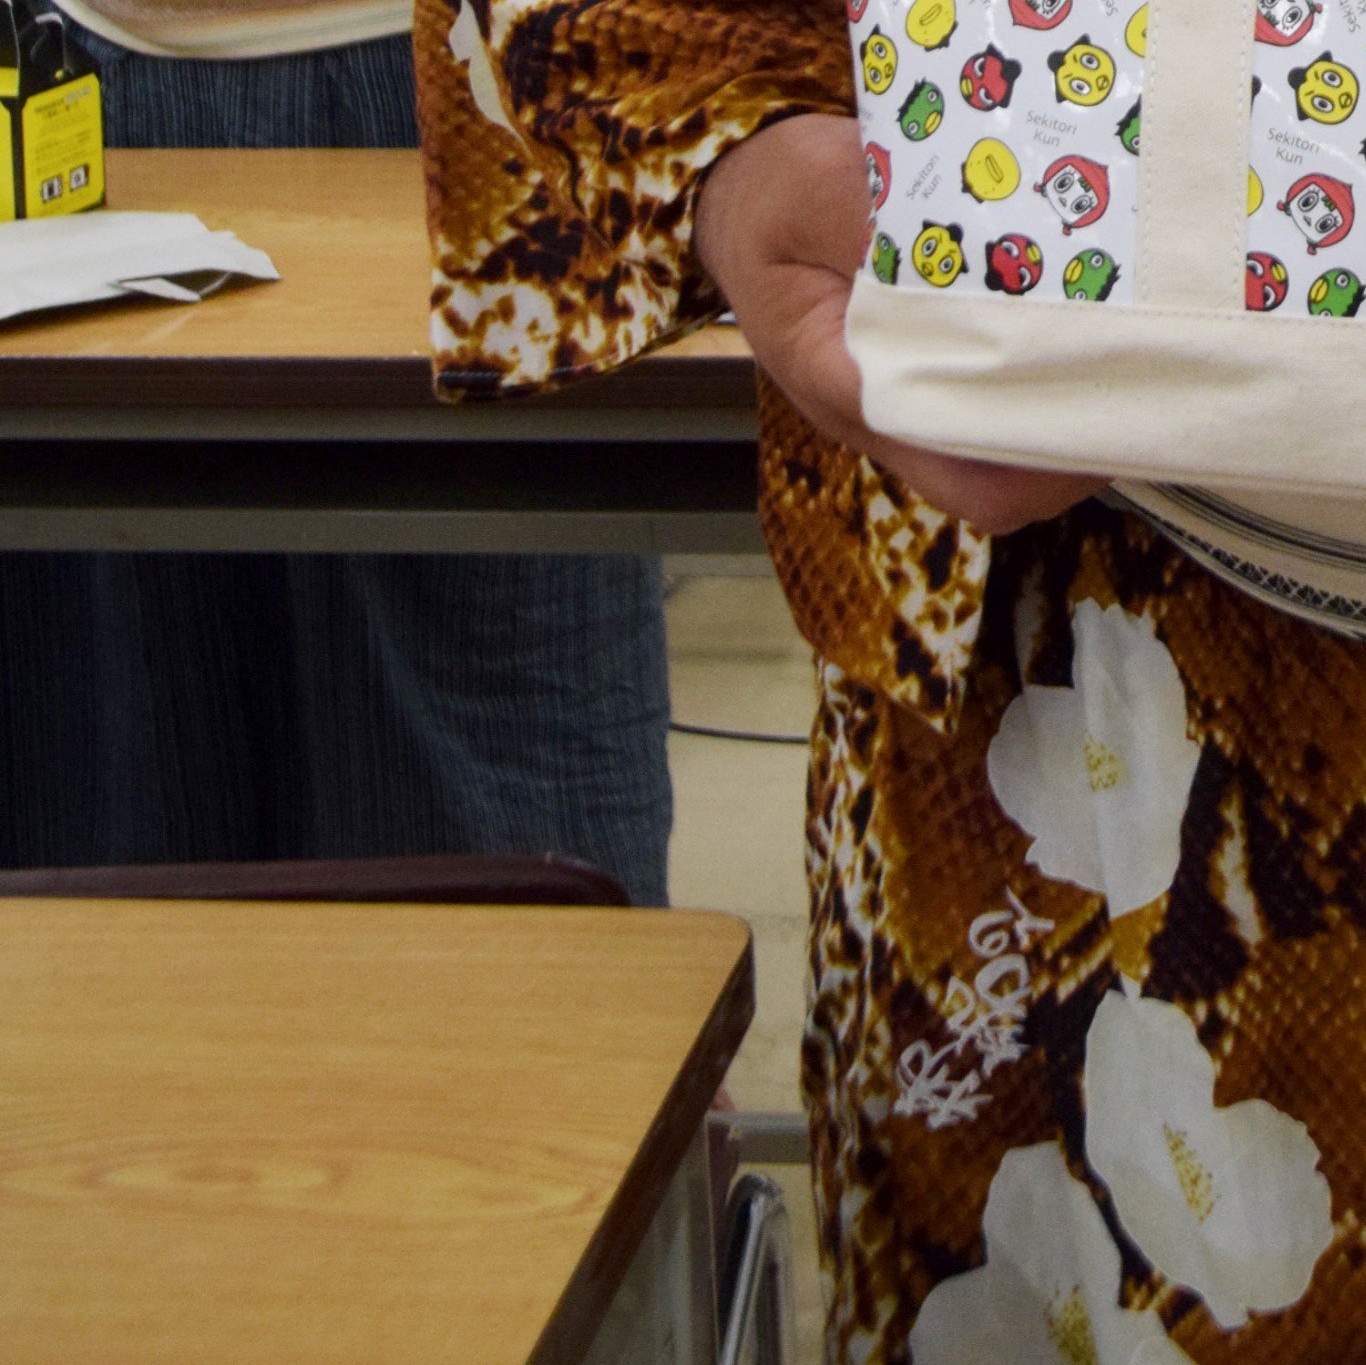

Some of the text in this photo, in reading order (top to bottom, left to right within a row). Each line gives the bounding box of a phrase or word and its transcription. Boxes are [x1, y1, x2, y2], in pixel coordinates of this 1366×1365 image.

[1026, 109, 1078, 136] Sekitori
[1033, 130, 1061, 148] Kun
[1267, 127, 1320, 154] Sekitori
[1275, 148, 1304, 165] Kun
[905, 155, 940, 201] Sekitori
[922, 174, 945, 201] Kun
